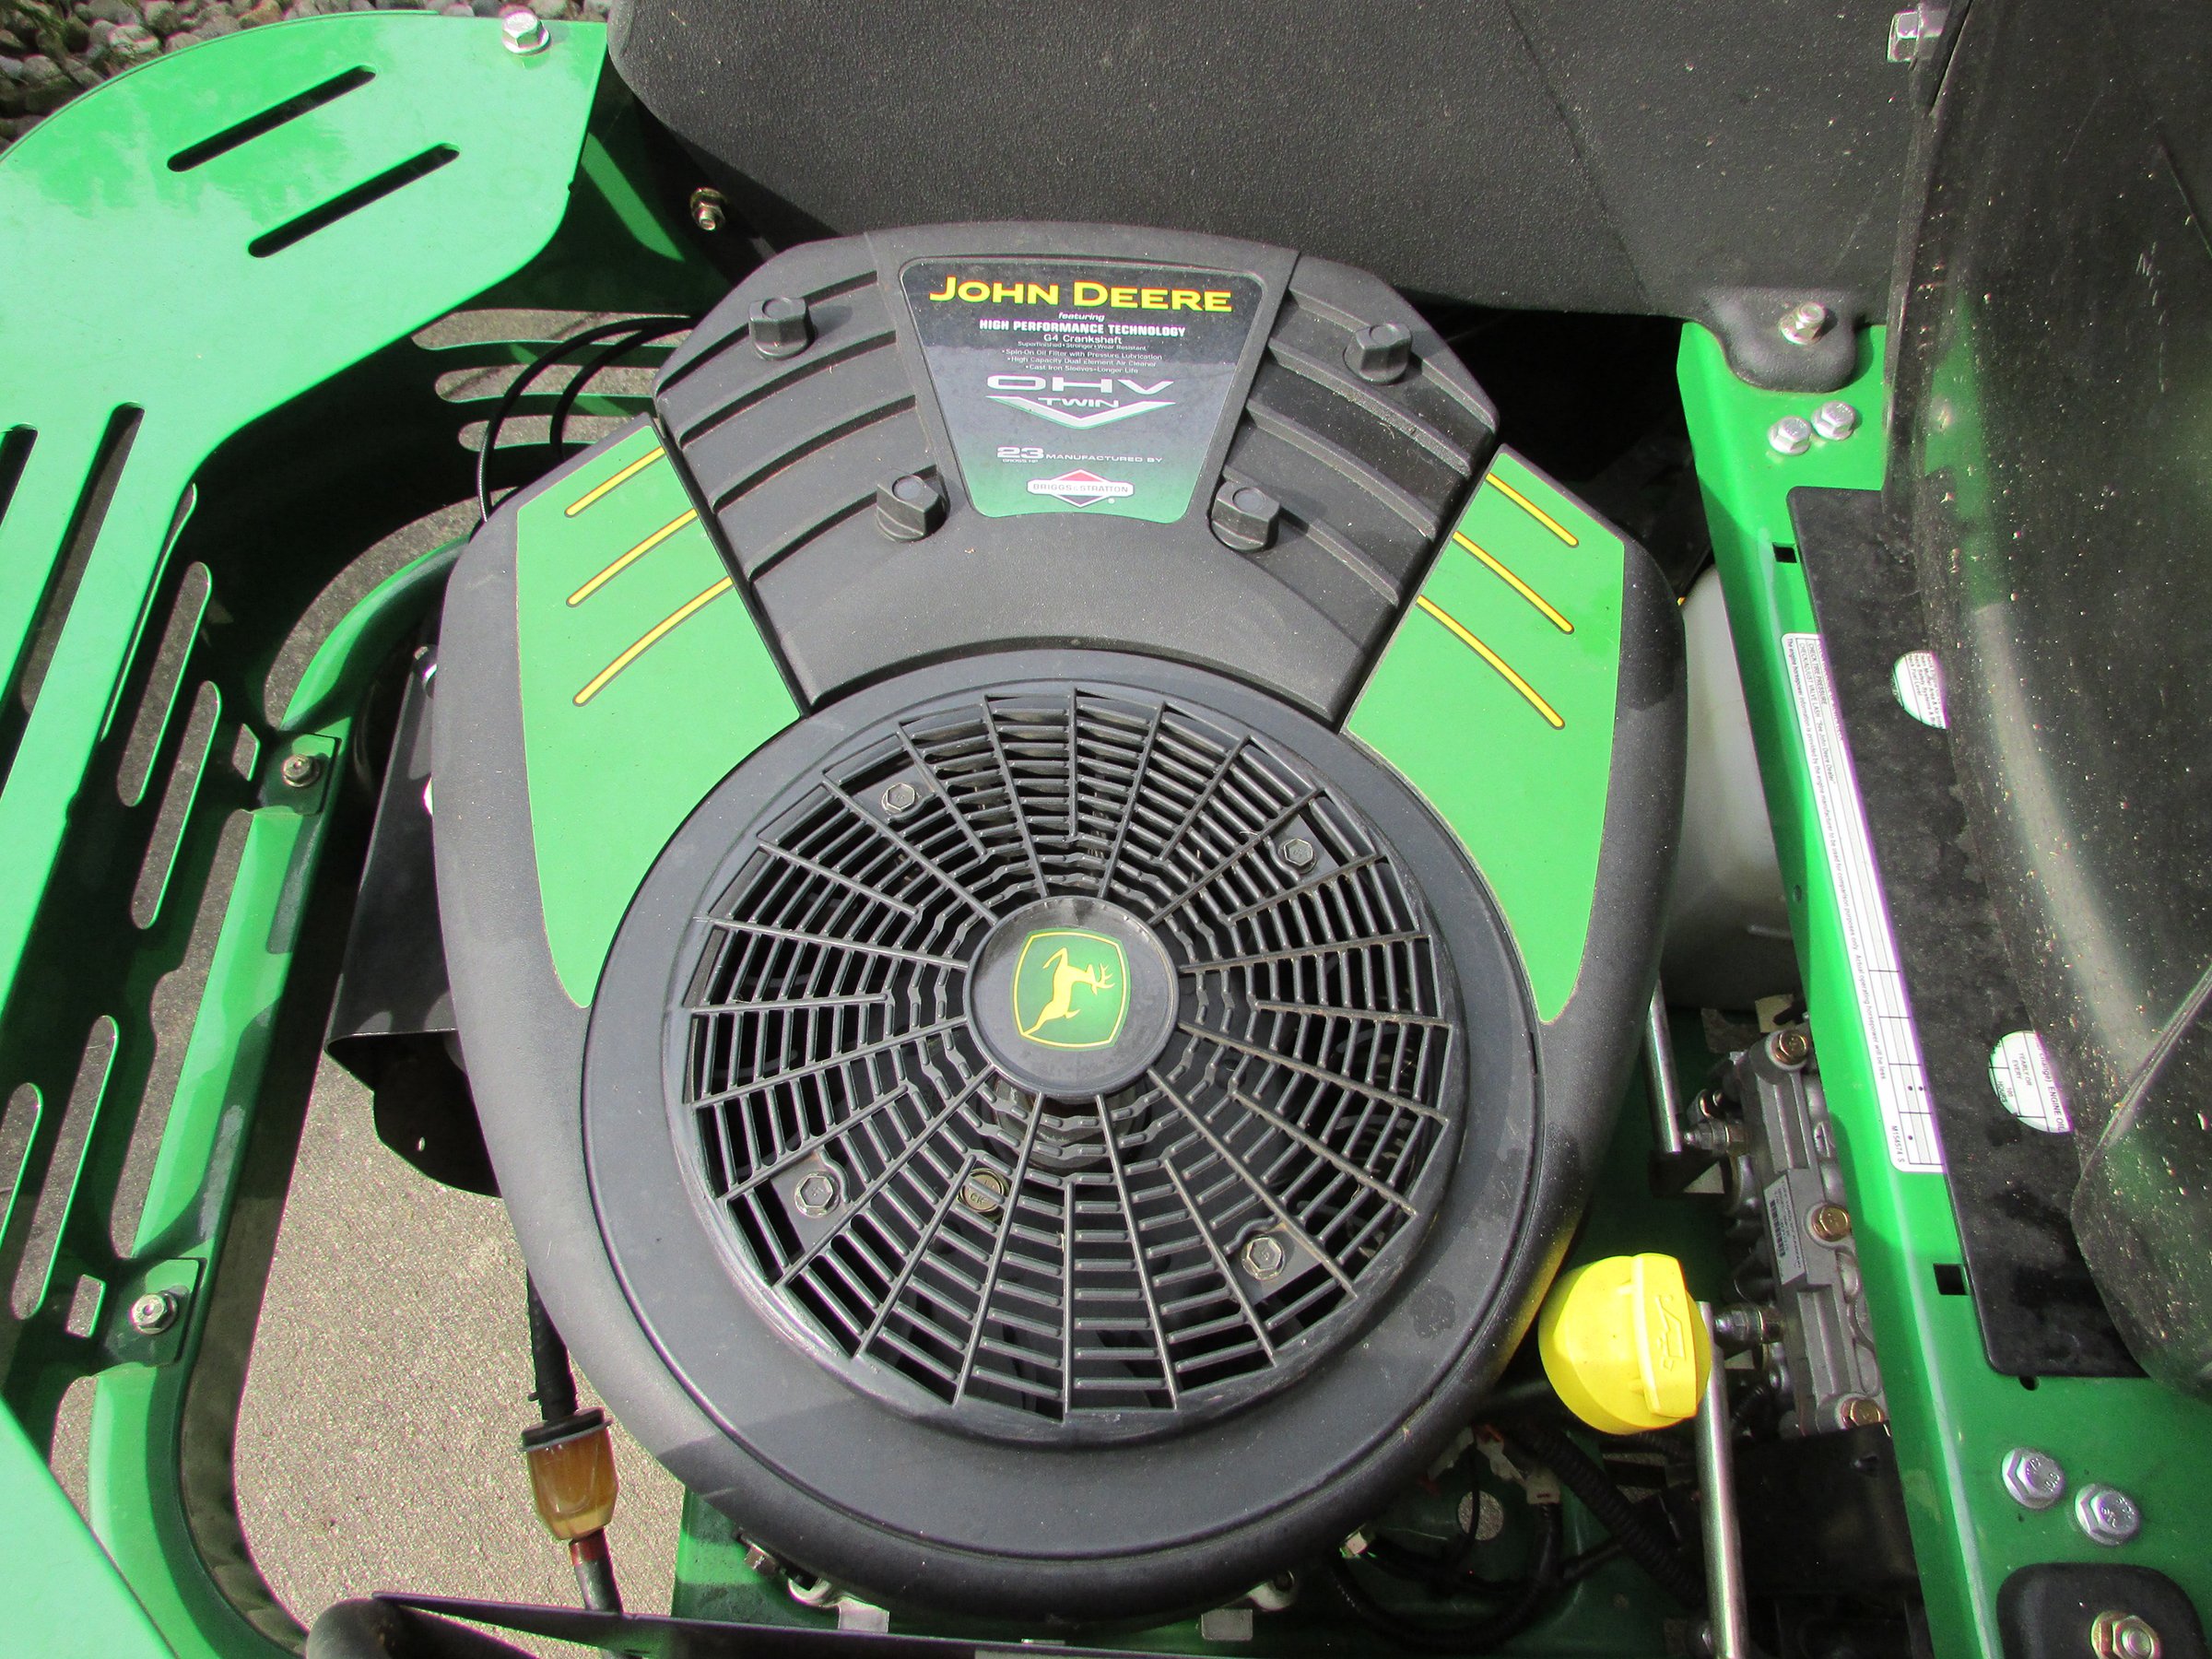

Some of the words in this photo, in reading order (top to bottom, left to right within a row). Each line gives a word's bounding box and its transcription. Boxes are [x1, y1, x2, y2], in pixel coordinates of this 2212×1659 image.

[929, 276, 1059, 306] JOHN
[1073, 280, 1232, 312] DEERE
[1058, 312, 1105, 323] featuring
[979, 319, 1010, 331] HIGH
[1013, 321, 1104, 335] PERFORMANCE
[1108, 324, 1185, 337] TECHNOLOGY
[1043, 334, 1059, 343] G4
[1063, 334, 1123, 345] Crankshaft
[1030, 357, 1063, 365] Capacity
[1083, 359, 1114, 367] Element
[1129, 360, 1157, 369] Cleaner
[1122, 353, 1162, 361] Lubrication
[987, 375, 1174, 395] OHV
[1038, 397, 1120, 408] TWIN
[996, 447, 1044, 459] 23
[1045, 453, 1144, 463] MANUFACTURED
[1033, 483, 1072, 491] BRIGGS
[1080, 485, 1129, 493] STRATTON
[1788, 648, 1796, 665] engine
[1792, 665, 1804, 695] horsepower
[1808, 643, 1818, 661] CHECK
[1816, 676, 1827, 704] PRESSURE
[1808, 684, 1817, 700] VALVE
[1799, 697, 1810, 726] information
[1812, 702, 1820, 717] LASH
[1806, 732, 1817, 756] provided
[1822, 747, 1830, 762] Deere
[1816, 775, 1825, 794] engine
[1820, 794, 1833, 830] manufacturer
[1837, 873, 1850, 906] comparison
[1843, 908, 1854, 935] purposes
[1855, 954, 1864, 972] Actual
[1859, 975, 1870, 1004] operating
[1865, 1006, 1879, 1044] horsepower
[2012, 1059, 2021, 1078] EVERY
[2018, 1053, 2029, 1075] YEARLY
[1996, 1081, 2007, 1102] HOURS
[2048, 1086, 2062, 1115] ENGINE
